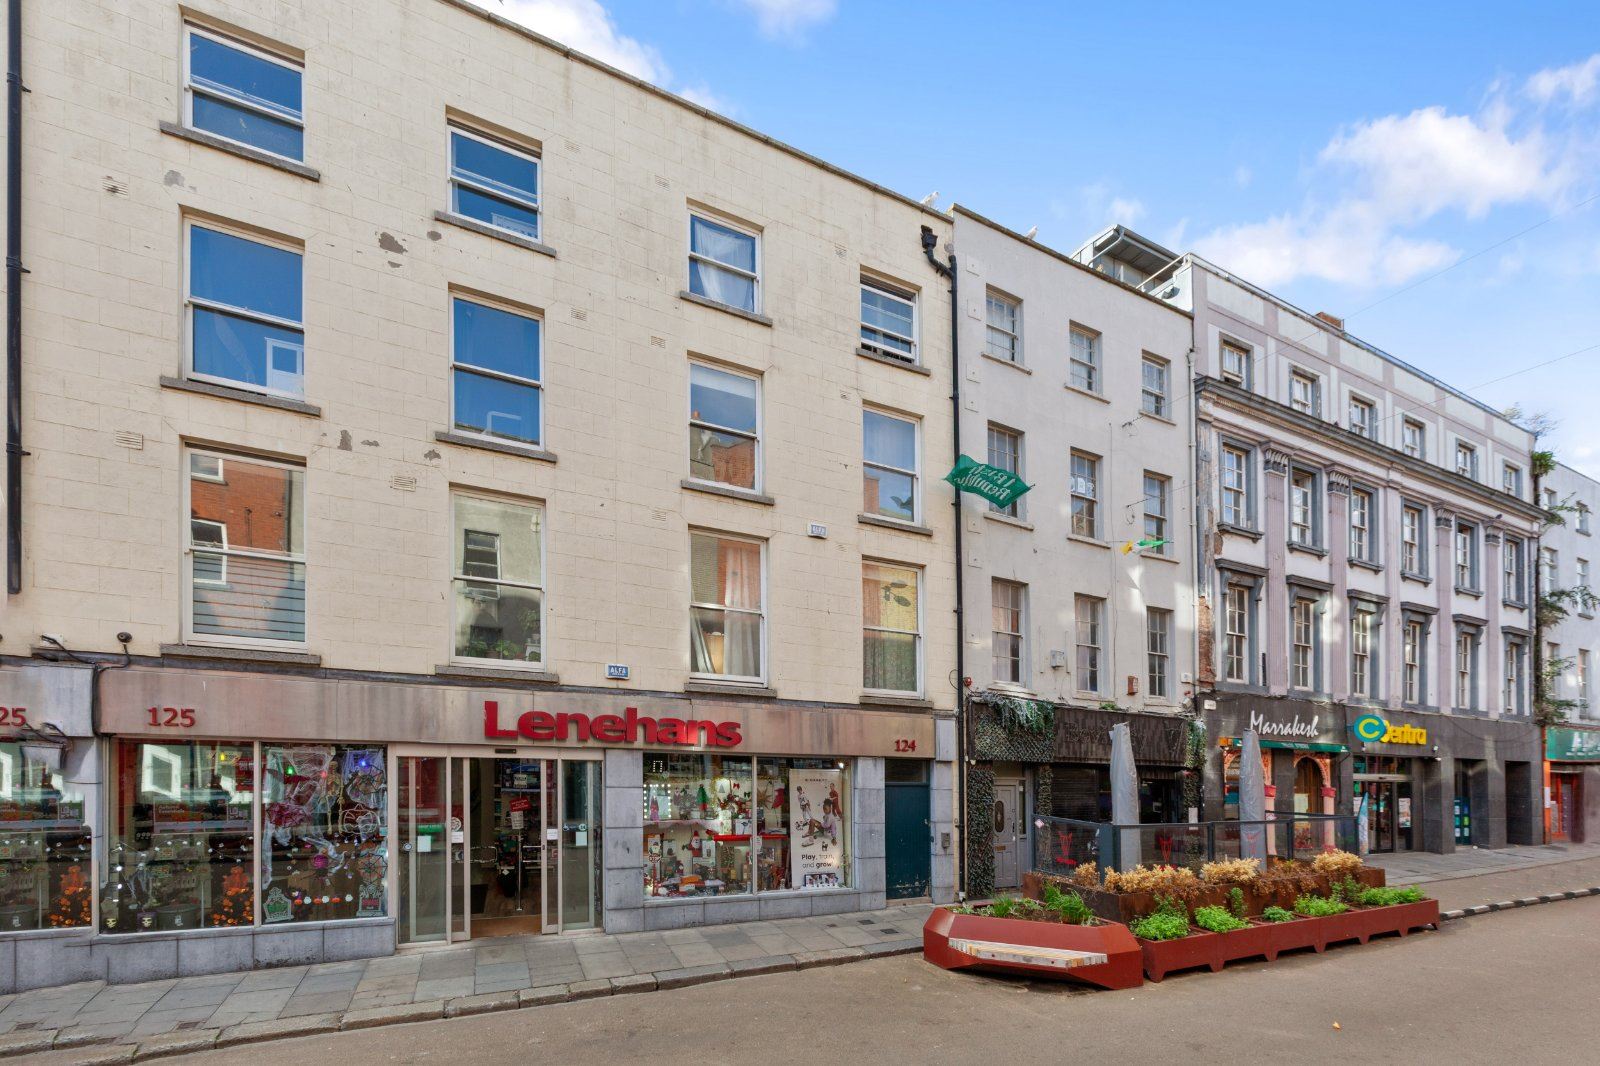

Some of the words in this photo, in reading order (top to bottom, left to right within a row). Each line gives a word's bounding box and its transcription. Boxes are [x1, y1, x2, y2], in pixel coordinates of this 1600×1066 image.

[610, 666, 627, 674] ALFA
[147, 706, 196, 728] 125
[484, 700, 743, 747] Lenehans
[1249, 709, 1320, 738] Marrakesh
[894, 739, 917, 753] 124
[801, 853, 818, 861] Play,
[815, 861, 832, 870] grow
